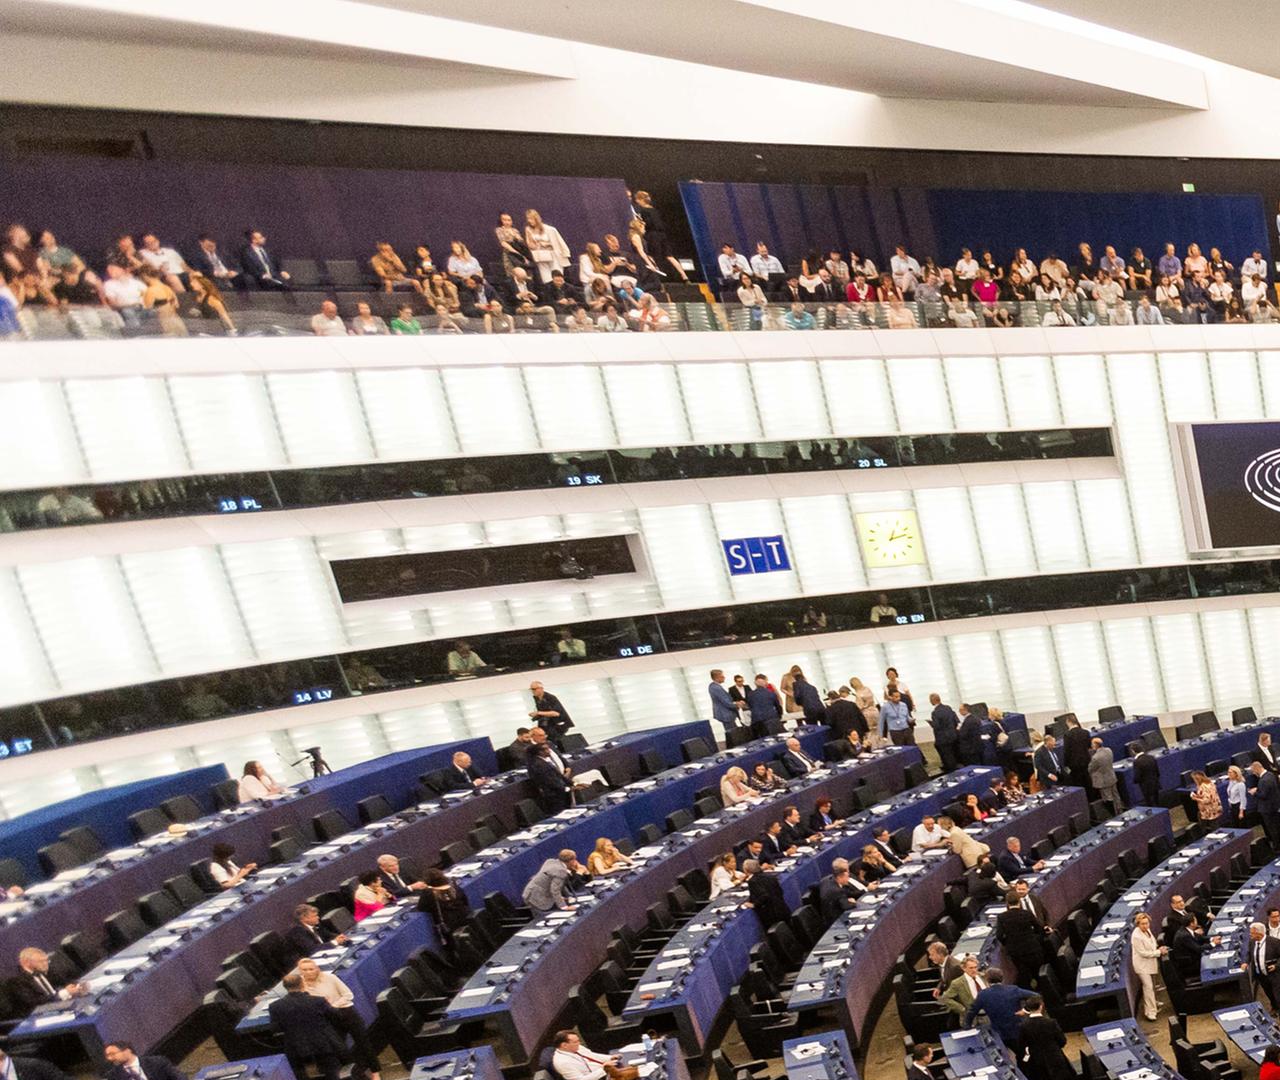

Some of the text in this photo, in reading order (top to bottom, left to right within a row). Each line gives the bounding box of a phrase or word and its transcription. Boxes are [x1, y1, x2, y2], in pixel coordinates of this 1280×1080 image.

[857, 457, 888, 468] 20 SL
[567, 474, 603, 486] 19 SK
[220, 498, 262, 512] 18 PL
[729, 541, 780, 569] S-T
[895, 613, 925, 625] 02 EN
[620, 644, 653, 657] 01 DE
[295, 689, 333, 704] 14 LV
[14, 738, 33, 754] ET
